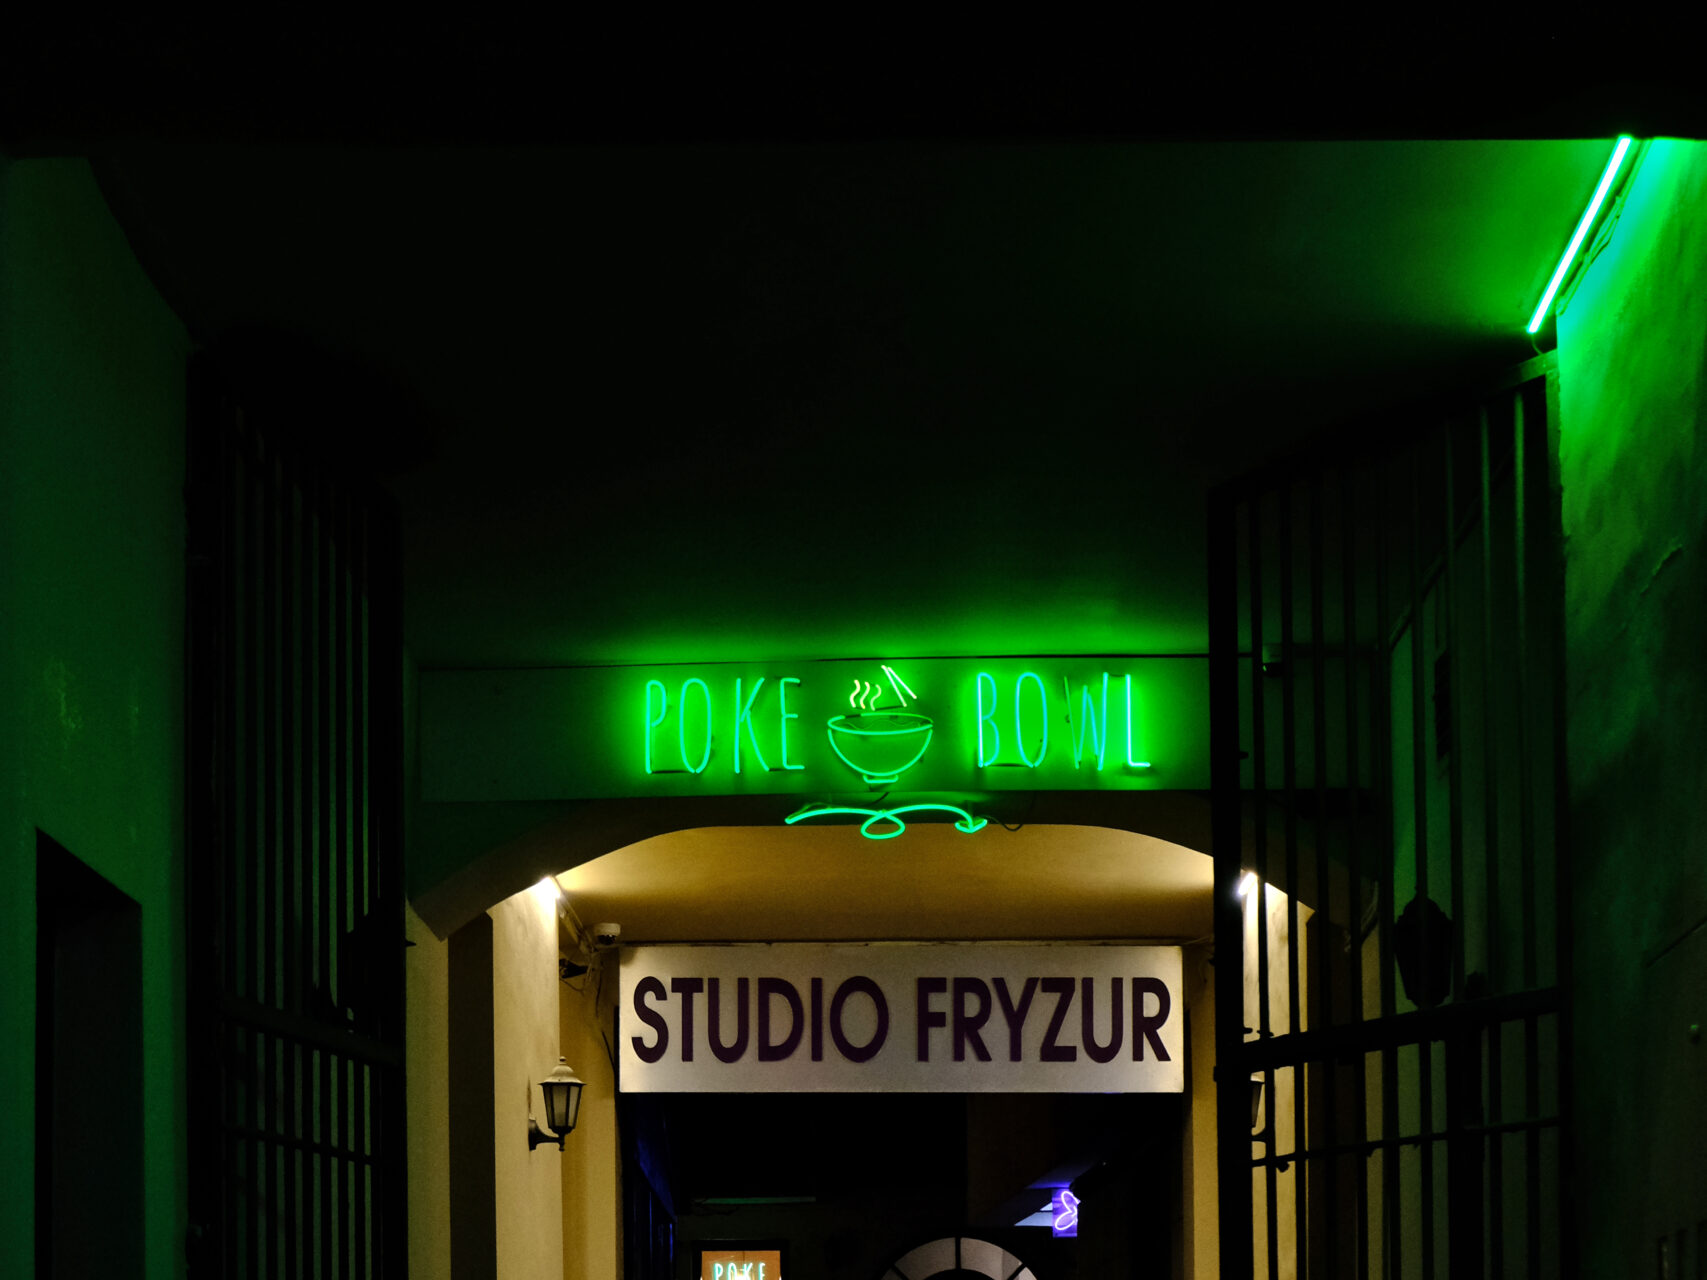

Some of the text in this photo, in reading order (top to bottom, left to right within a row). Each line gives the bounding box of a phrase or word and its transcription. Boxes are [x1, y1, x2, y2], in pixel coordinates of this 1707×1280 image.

[645, 672, 1151, 773] POKE BOWL
[631, 976, 1171, 1063] STUDIO FRYZUR
